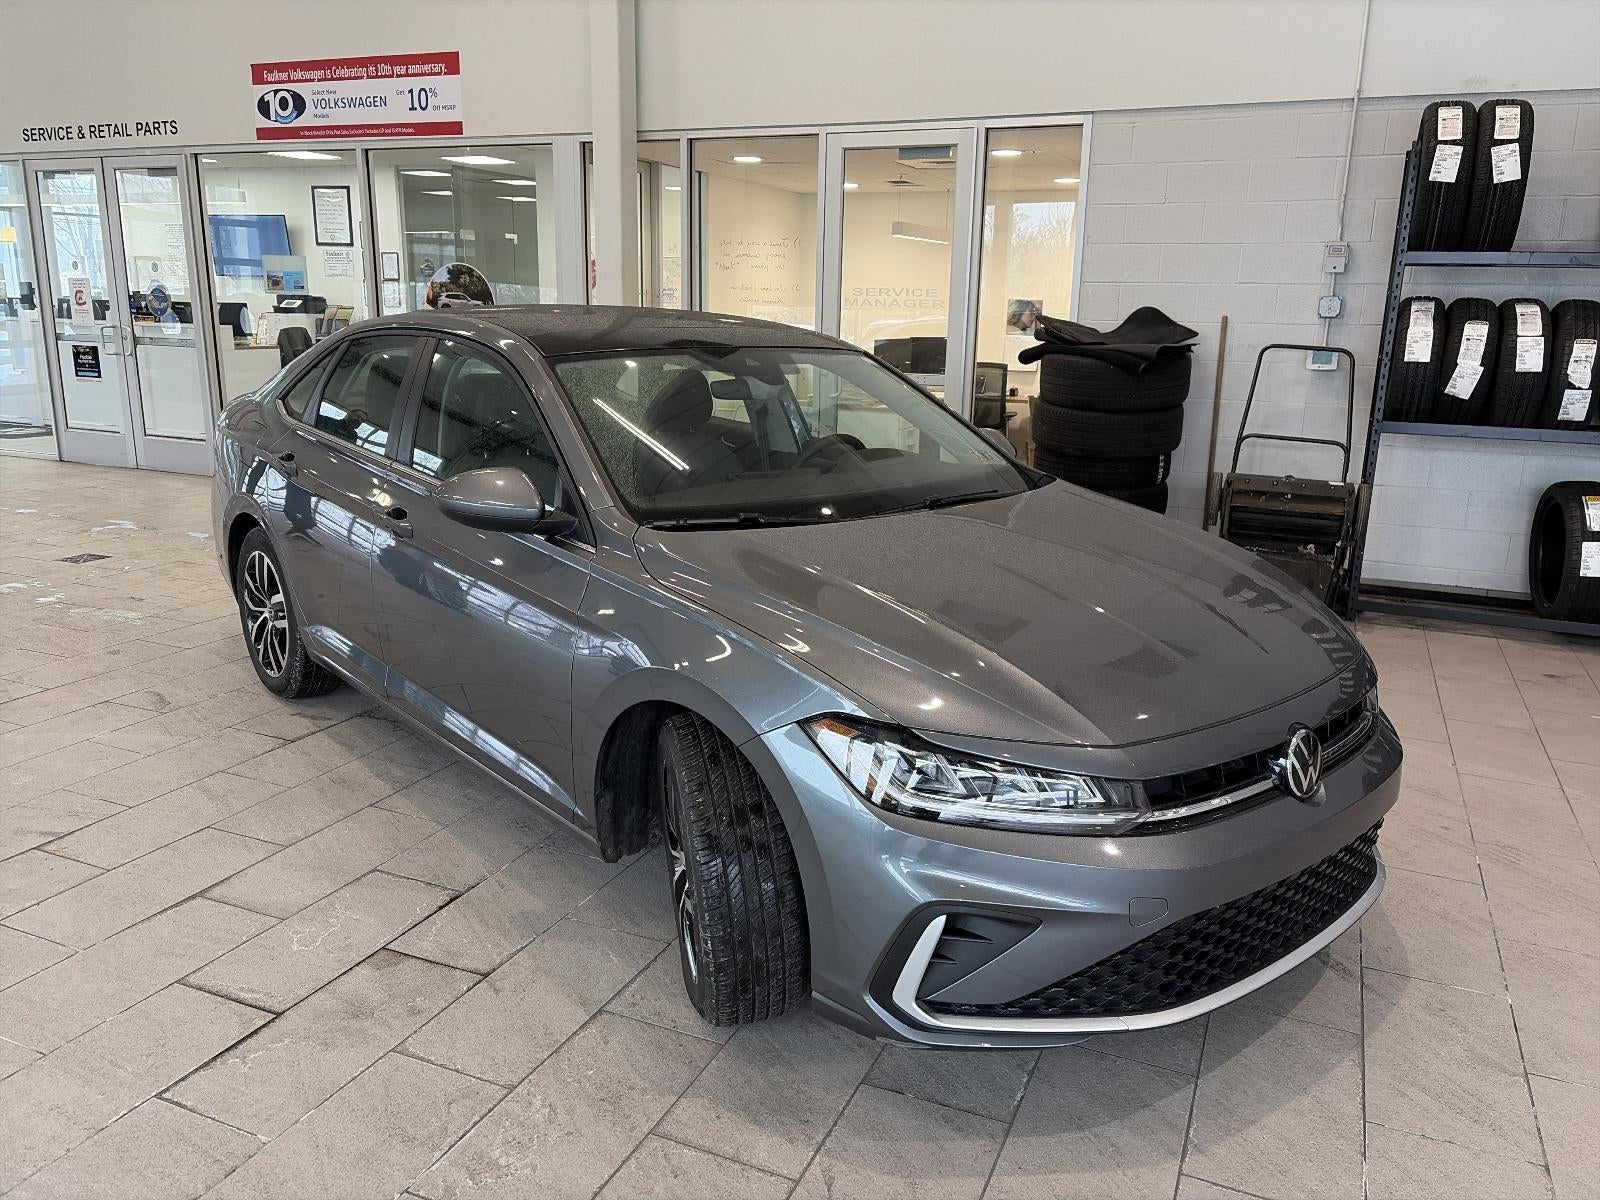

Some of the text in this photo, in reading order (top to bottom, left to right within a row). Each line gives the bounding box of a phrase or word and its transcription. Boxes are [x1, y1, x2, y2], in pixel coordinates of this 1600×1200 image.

[264, 61, 447, 82] Faulkner Volkswagen is Celebrating its 10th year anniversary.
[264, 90, 294, 120] 10
[312, 95, 387, 110] VOLKSWAGEN
[22, 120, 179, 142] SERVICE & RETAIL PARTS
[852, 287, 937, 298] SERVICE
[844, 297, 945, 309] MANAGER
